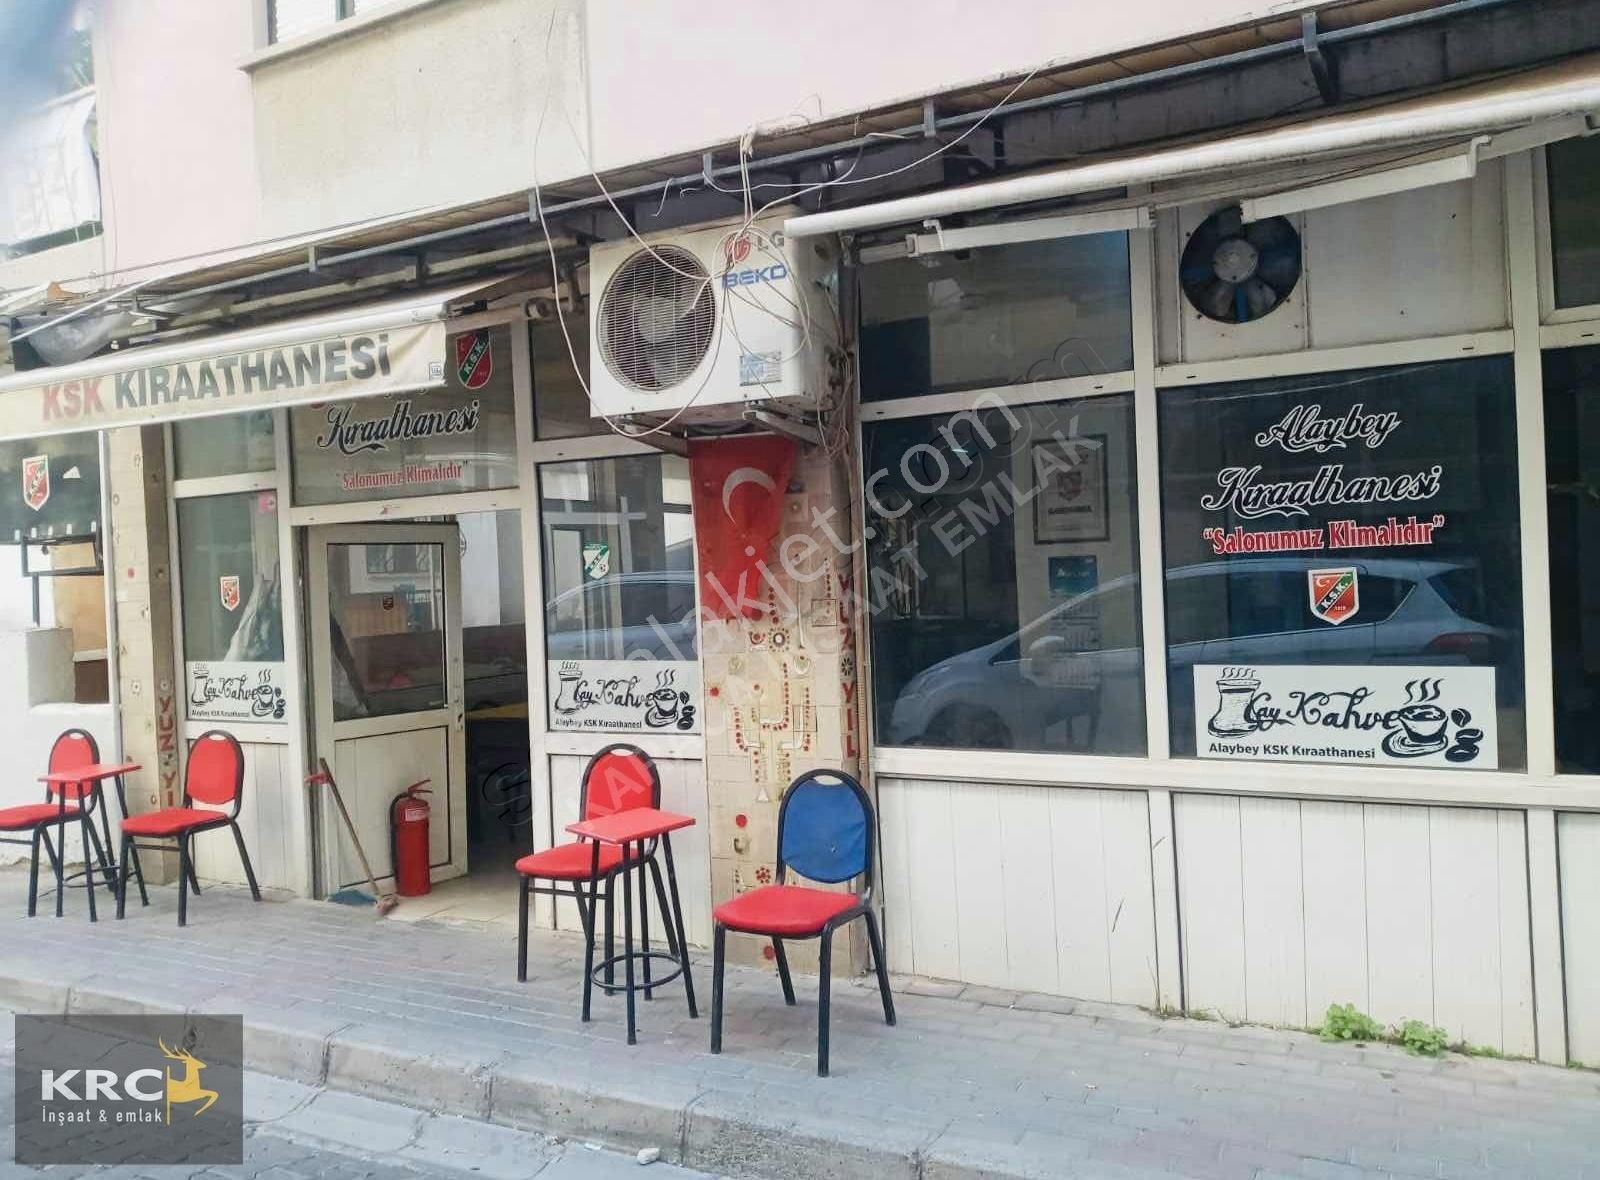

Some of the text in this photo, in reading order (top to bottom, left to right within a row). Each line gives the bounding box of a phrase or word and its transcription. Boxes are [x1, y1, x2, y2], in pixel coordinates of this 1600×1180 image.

[721, 264, 788, 289] BEKO
[41, 377, 106, 421] KSK
[1255, 403, 1402, 453] Alaybey
[584, 719, 599, 727] KSK
[1287, 687, 1402, 730] Kahve
[1209, 742, 1376, 759] Alaybey KSK Kıraathanesi
